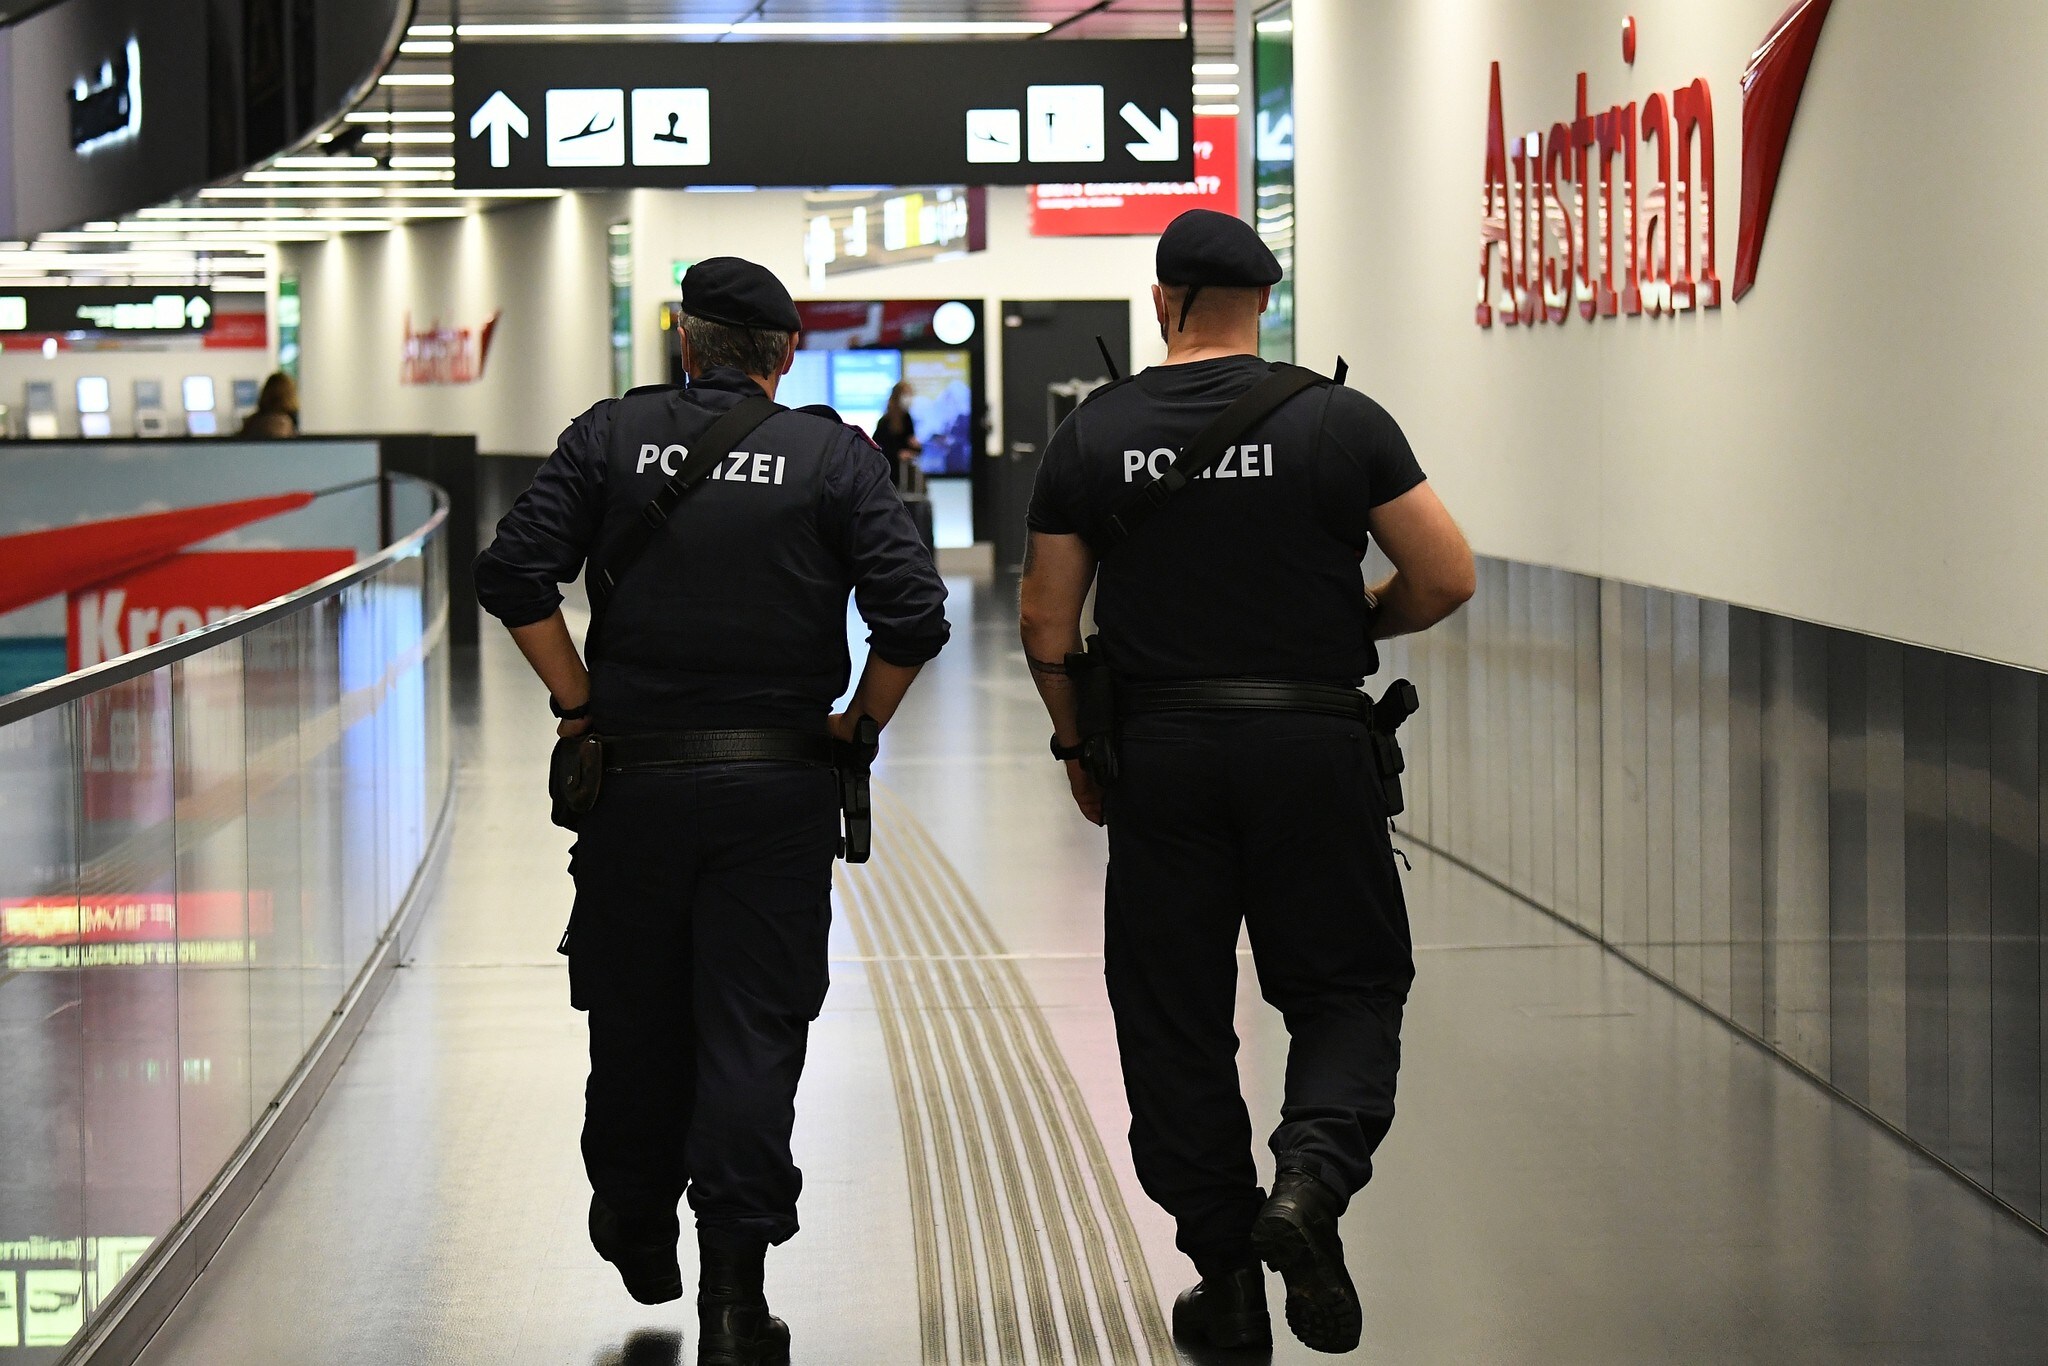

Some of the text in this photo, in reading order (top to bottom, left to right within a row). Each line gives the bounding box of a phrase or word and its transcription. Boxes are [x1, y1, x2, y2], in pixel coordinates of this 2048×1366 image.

[1475, 15, 1722, 328] Austrian
[635, 443, 786, 485] POZEI
[1123, 443, 1273, 483] POZEI
